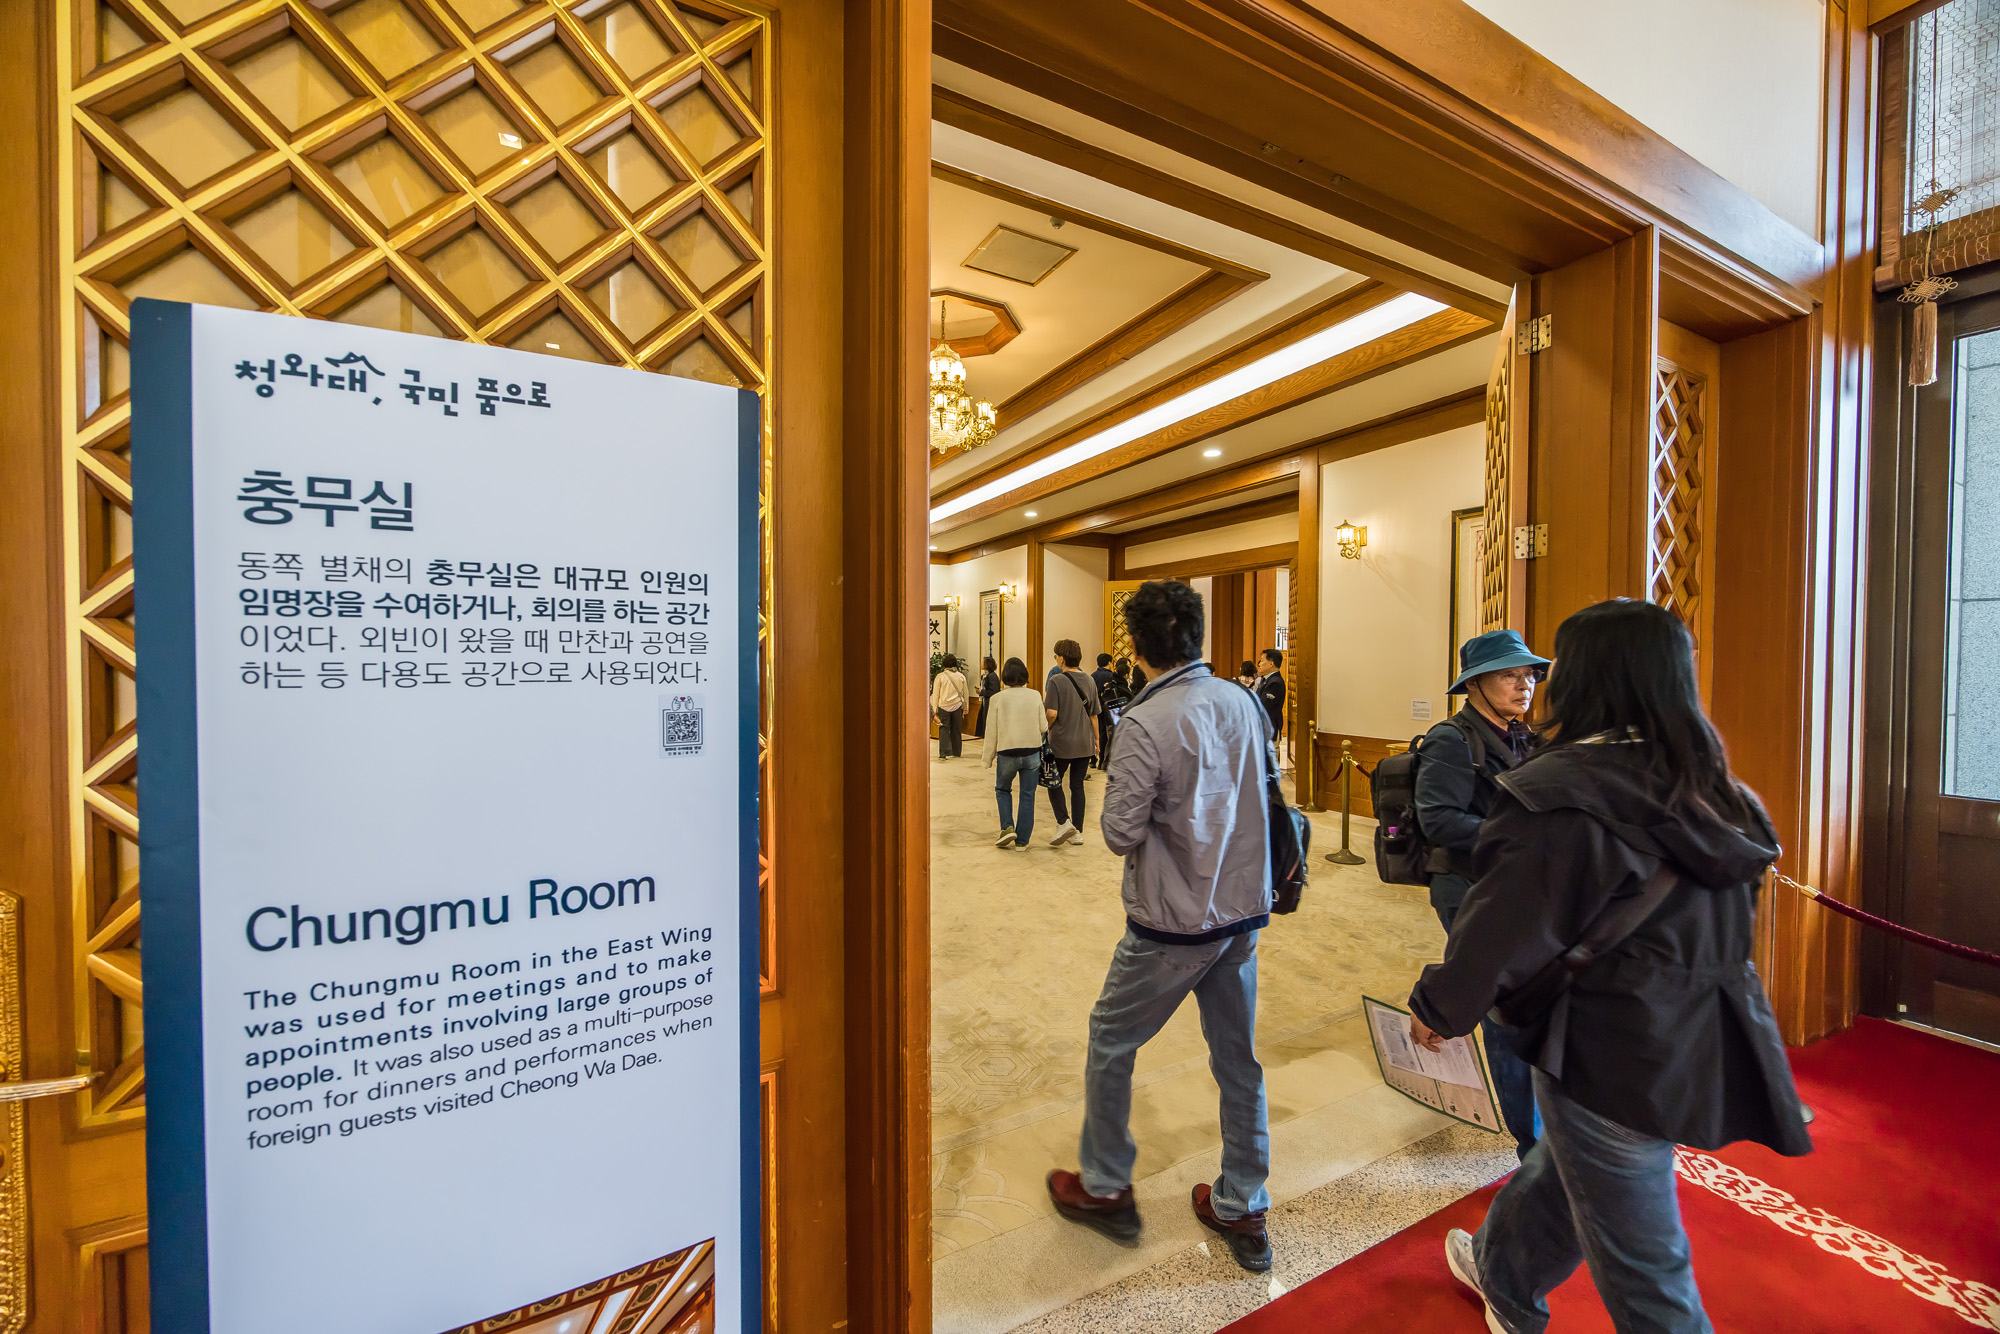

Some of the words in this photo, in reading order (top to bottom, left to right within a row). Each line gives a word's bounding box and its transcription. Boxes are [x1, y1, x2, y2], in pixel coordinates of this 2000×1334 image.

[234, 351, 386, 406] 청와대,
[398, 368, 459, 418] 국민
[475, 377, 552, 417] 품으로
[236, 469, 415, 532] 충무실
[237, 551, 304, 582] 동쪽
[320, 555, 411, 585] 별채의
[425, 558, 542, 589] 충무실은
[554, 565, 630, 592] 대규모
[640, 570, 708, 597] 인원의
[238, 588, 366, 619] 임명장을
[372, 592, 523, 623] 수여하거나,
[531, 596, 607, 624] 회의를
[612, 599, 660, 625] 하는
[664, 601, 711, 626] 공간
[239, 624, 346, 654] 이었다.
[359, 626, 447, 654] 외빈이
[457, 627, 515, 654] 왔을
[524, 628, 549, 654] 때
[558, 629, 635, 655] 만찬과
[640, 631, 710, 656] 공연을
[239, 661, 306, 690] 하는
[316, 661, 349, 690] 등
[361, 660, 452, 689] 다용도
[461, 660, 573, 688] 공간으로
[580, 660, 708, 686] 사용되었다.
[245, 894, 510, 953] Chungmu
[529, 875, 656, 920] Room
[242, 989, 297, 1011] The
[309, 971, 440, 1002] Chungmu
[451, 959, 521, 984] Room
[532, 952, 552, 970] in
[560, 946, 598, 965] the
[608, 935, 654, 957] East
[660, 927, 712, 947] Wing
[243, 1018, 303, 1039] was
[317, 1000, 385, 1029] used
[396, 997, 437, 1017] for
[447, 977, 566, 1009] meetings
[576, 962, 617, 986] and
[626, 961, 648, 977] to
[657, 948, 712, 971] make
[244, 1023, 433, 1069] appointments
[443, 1004, 548, 1035] involving
[557, 992, 611, 1014] large
[618, 977, 687, 1005] groups
[694, 966, 713, 986] of
[246, 1064, 343, 1100] people.
[353, 1058, 369, 1077] It
[374, 1053, 423, 1073] was
[429, 1043, 474, 1064] also
[481, 1027, 532, 1054] used
[538, 1026, 562, 1043] as
[566, 1023, 578, 1036] a
[584, 992, 714, 1034] multi-purpose
[247, 1099, 313, 1123] room
[323, 1089, 359, 1109] for
[367, 1072, 457, 1101] dinners
[464, 1057, 506, 1083] and
[514, 1028, 657, 1076] performances
[662, 1016, 713, 1038] when
[247, 1123, 331, 1150] foreign
[338, 1105, 417, 1137] guests
[423, 1084, 494, 1116] visited
[500, 1071, 579, 1099] Cheong
[583, 1059, 616, 1080] Wa
[622, 1052, 663, 1073] Dae.
